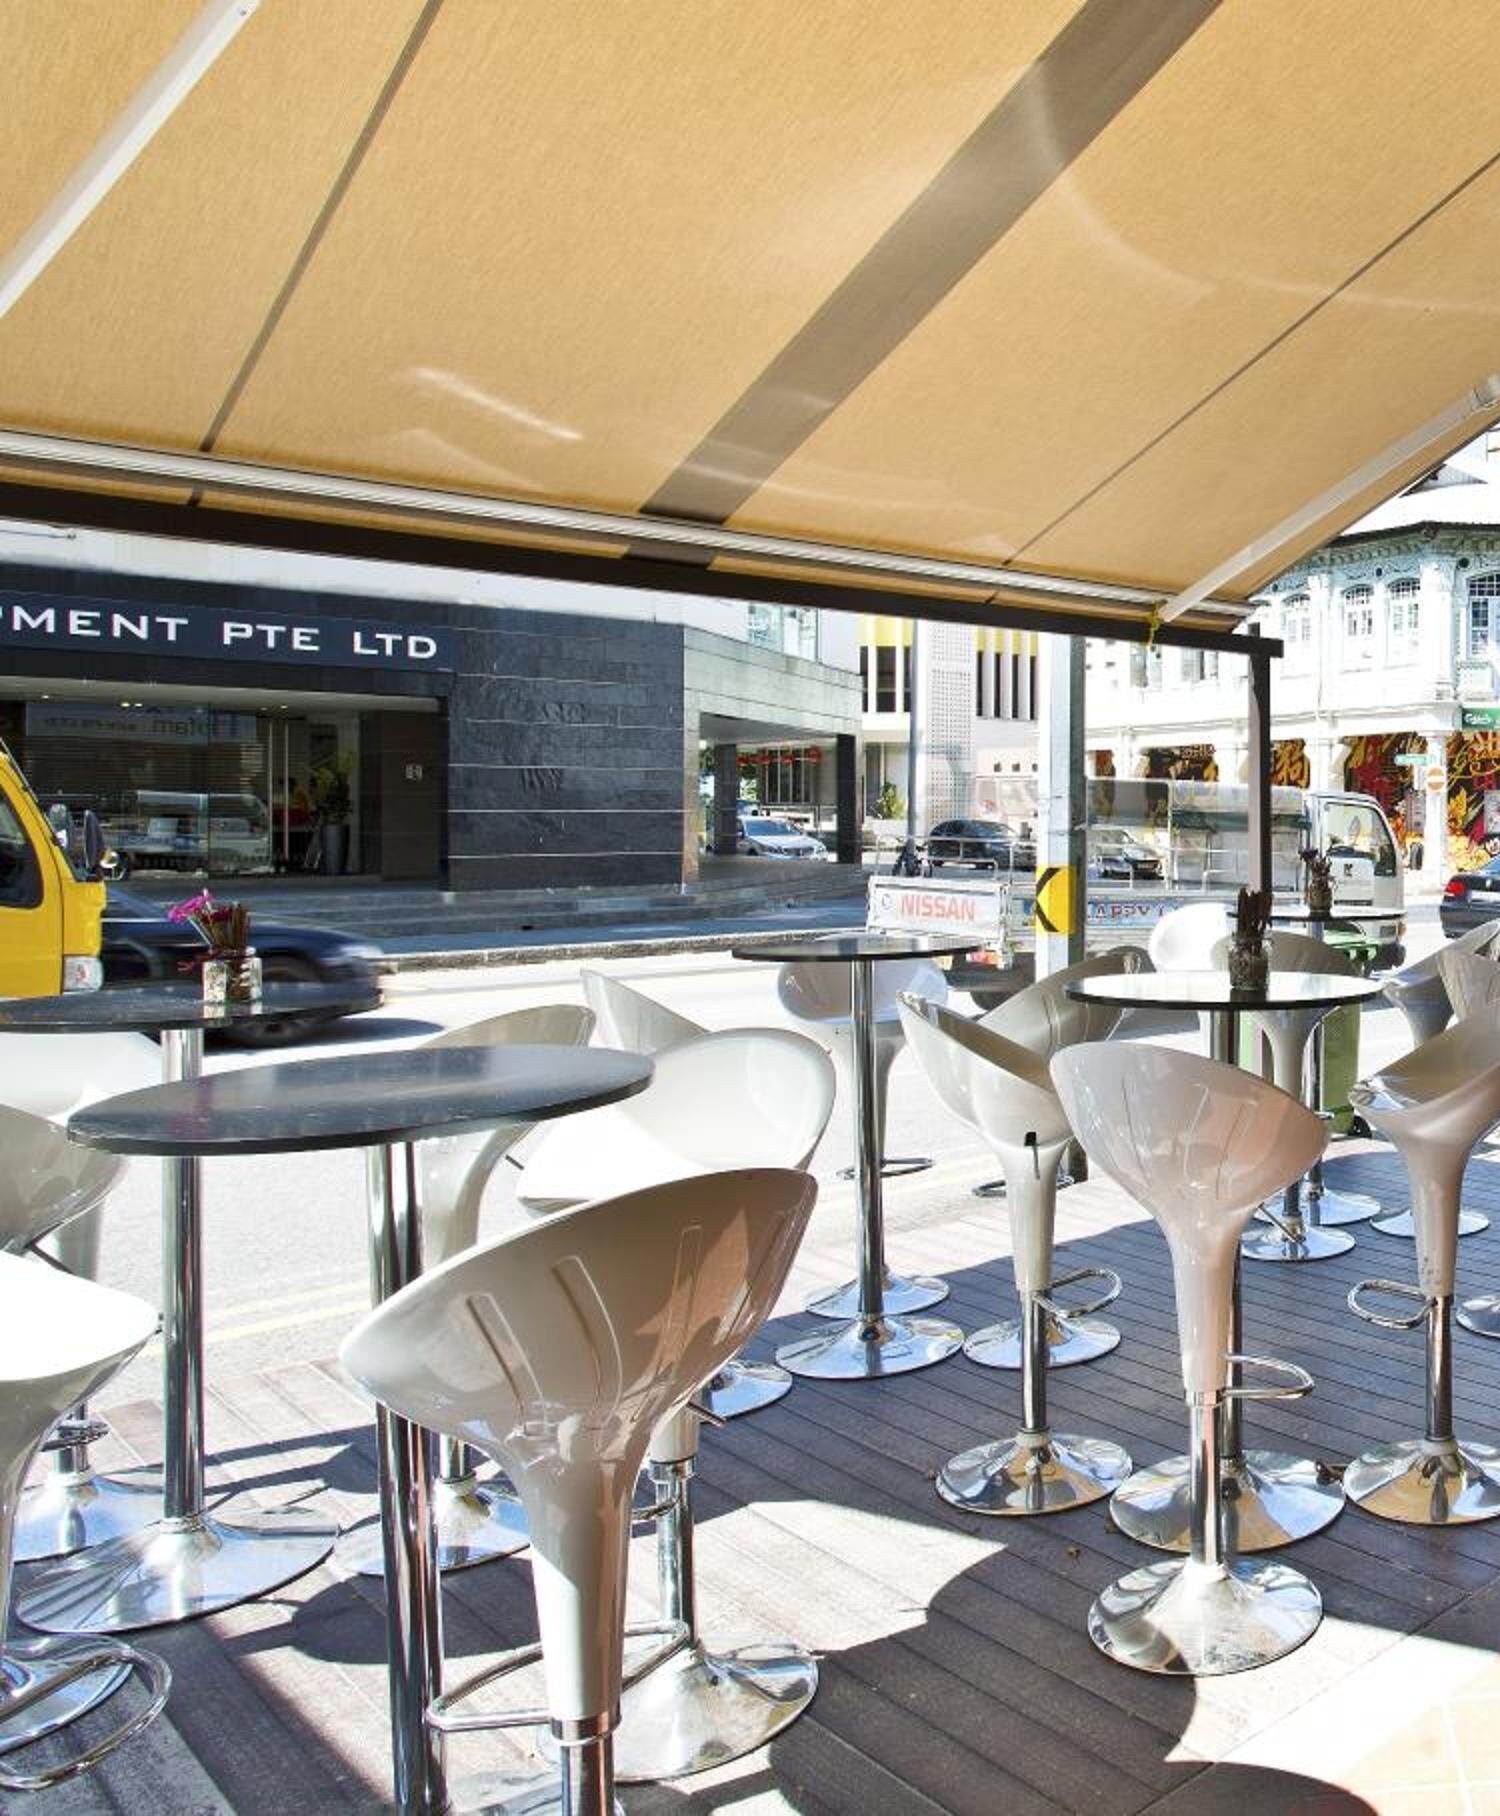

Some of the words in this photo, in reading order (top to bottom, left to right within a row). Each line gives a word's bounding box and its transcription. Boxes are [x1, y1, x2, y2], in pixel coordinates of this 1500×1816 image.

[0, 605, 189, 642] MENT
[223, 621, 321, 652] PTE
[353, 630, 438, 659] LTD
[899, 893, 977, 921] NISSAN
[1087, 903, 1151, 919] APPY
